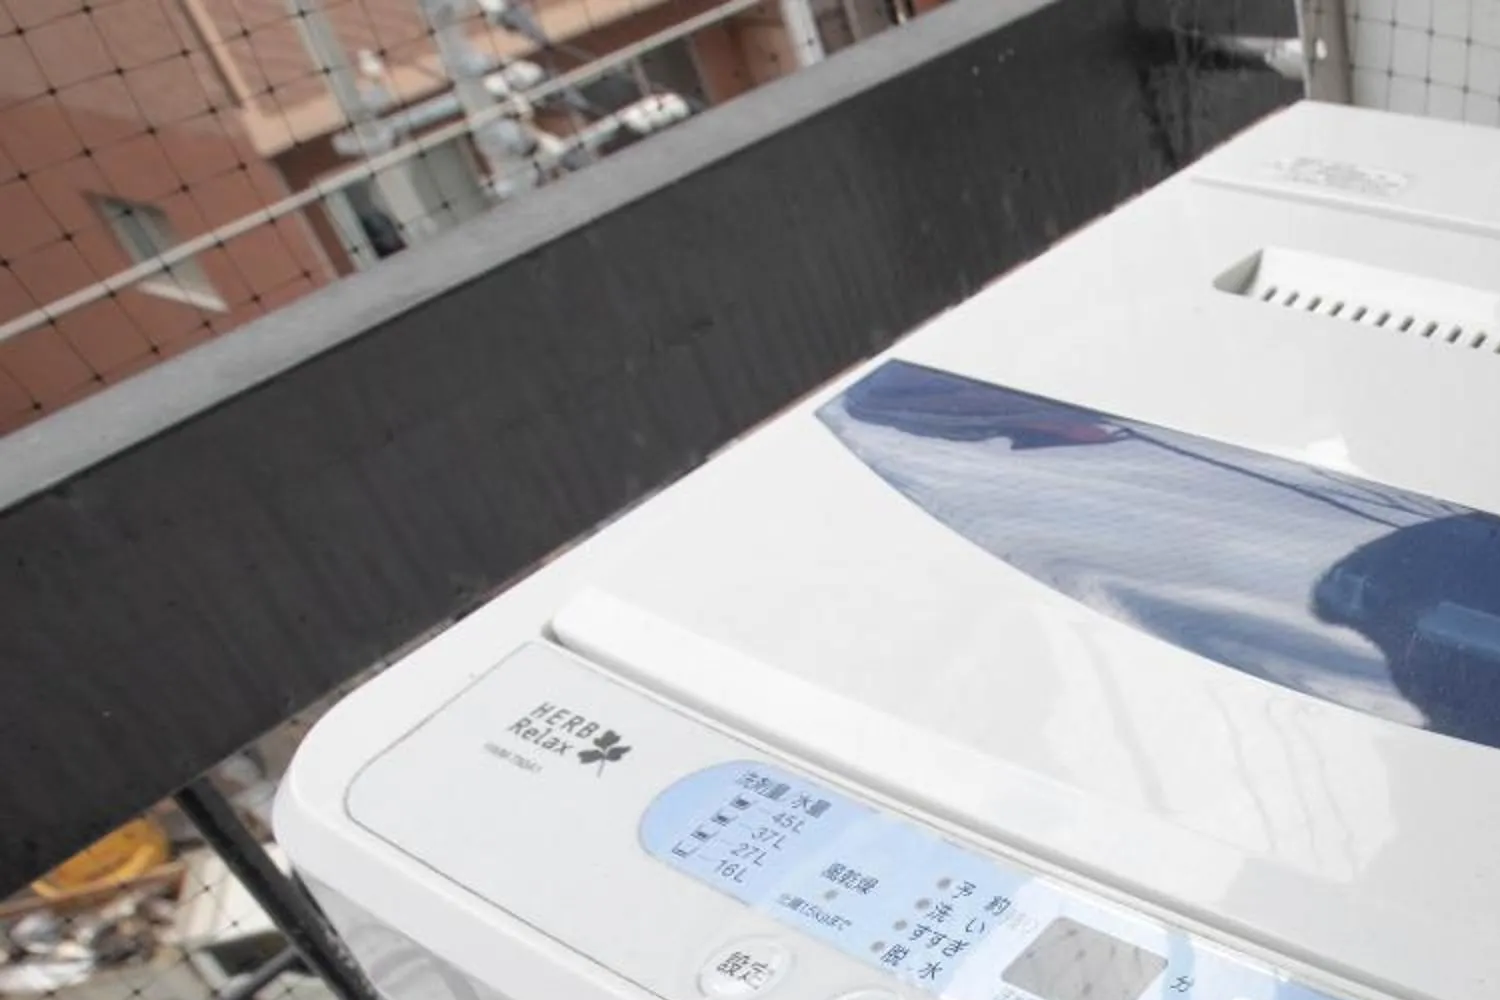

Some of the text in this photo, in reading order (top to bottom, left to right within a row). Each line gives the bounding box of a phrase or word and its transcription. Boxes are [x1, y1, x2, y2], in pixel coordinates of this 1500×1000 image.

[529, 701, 600, 739] HERB
[506, 716, 574, 756] Relax
[772, 812, 805, 834] 45L
[751, 827, 787, 850] 37L
[729, 842, 767, 867] 27L
[714, 859, 748, 884] 16L
[908, 923, 970, 957] すすぎ
[716, 951, 776, 990] 設定
[1170, 976, 1194, 993] 分
